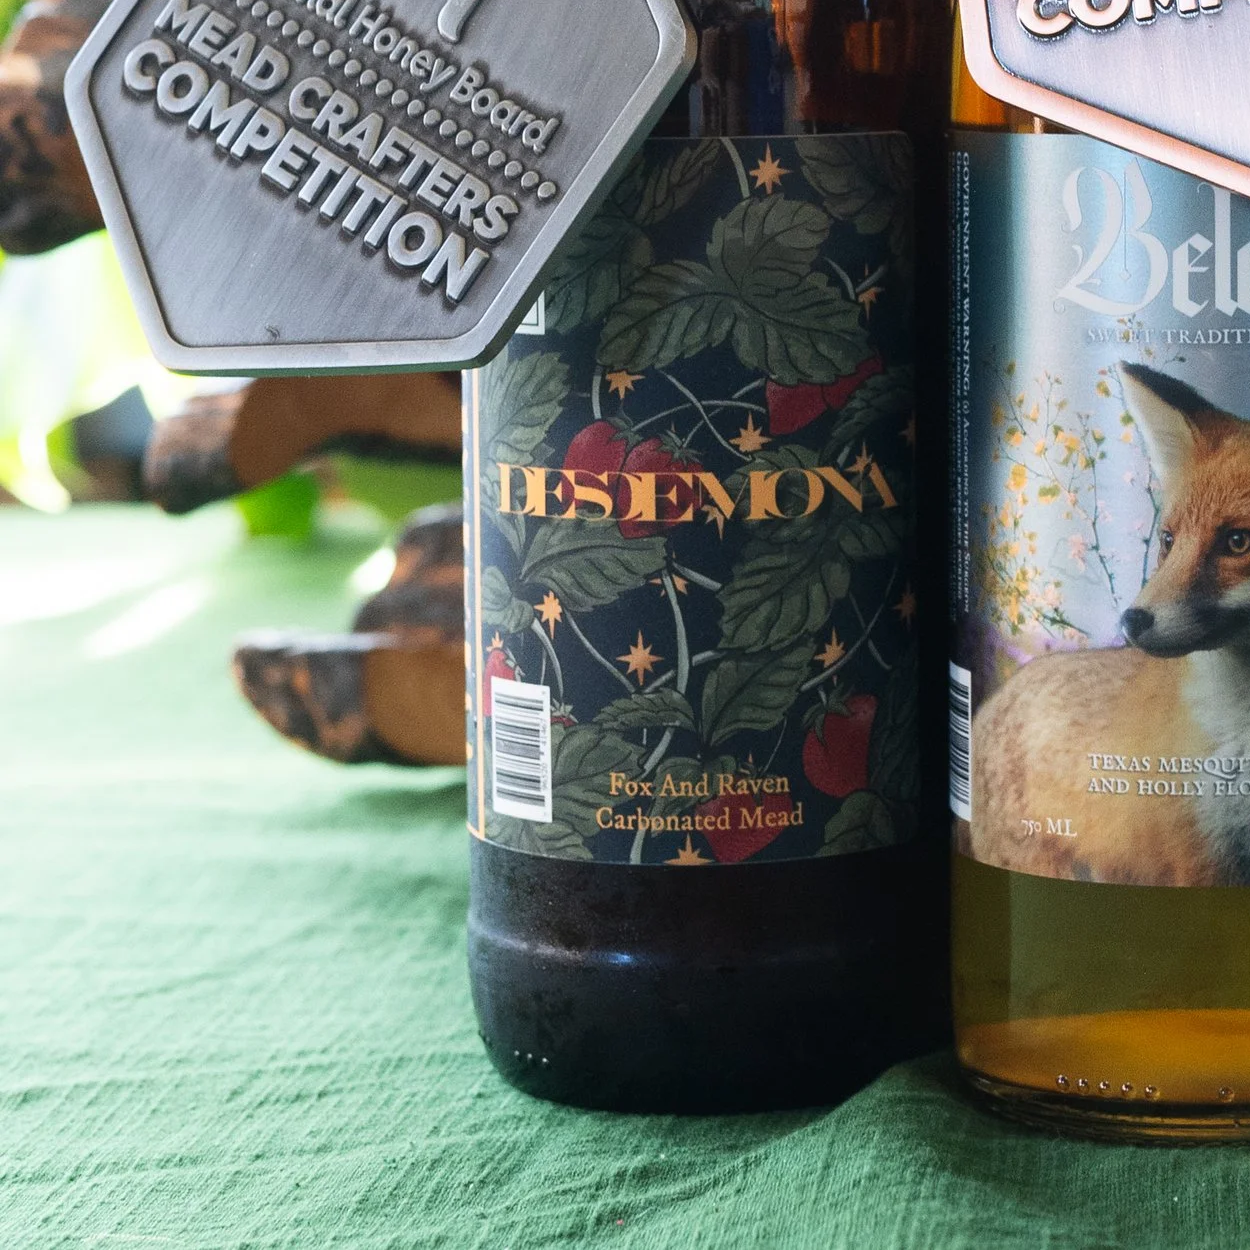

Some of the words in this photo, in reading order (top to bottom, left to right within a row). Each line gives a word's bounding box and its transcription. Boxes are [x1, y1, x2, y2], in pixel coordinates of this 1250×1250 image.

[353, 6, 457, 94] Honey
[453, 68, 562, 153] Board
[123, 40, 490, 303] COMPETITION
[289, 77, 519, 245] CRAFTERS
[1087, 327, 1160, 345] SWEET
[1088, 753, 1151, 773] TEXAS
[608, 771, 653, 798] Fox
[658, 772, 710, 798] And
[716, 773, 791, 797] Raven
[1087, 777, 1130, 794] AND
[1136, 777, 1207, 796] HOLLY
[595, 806, 732, 832] Carbonated
[737, 801, 805, 829] Mead
[1021, 818, 1043, 837] 750
[1045, 817, 1079, 839] ML
